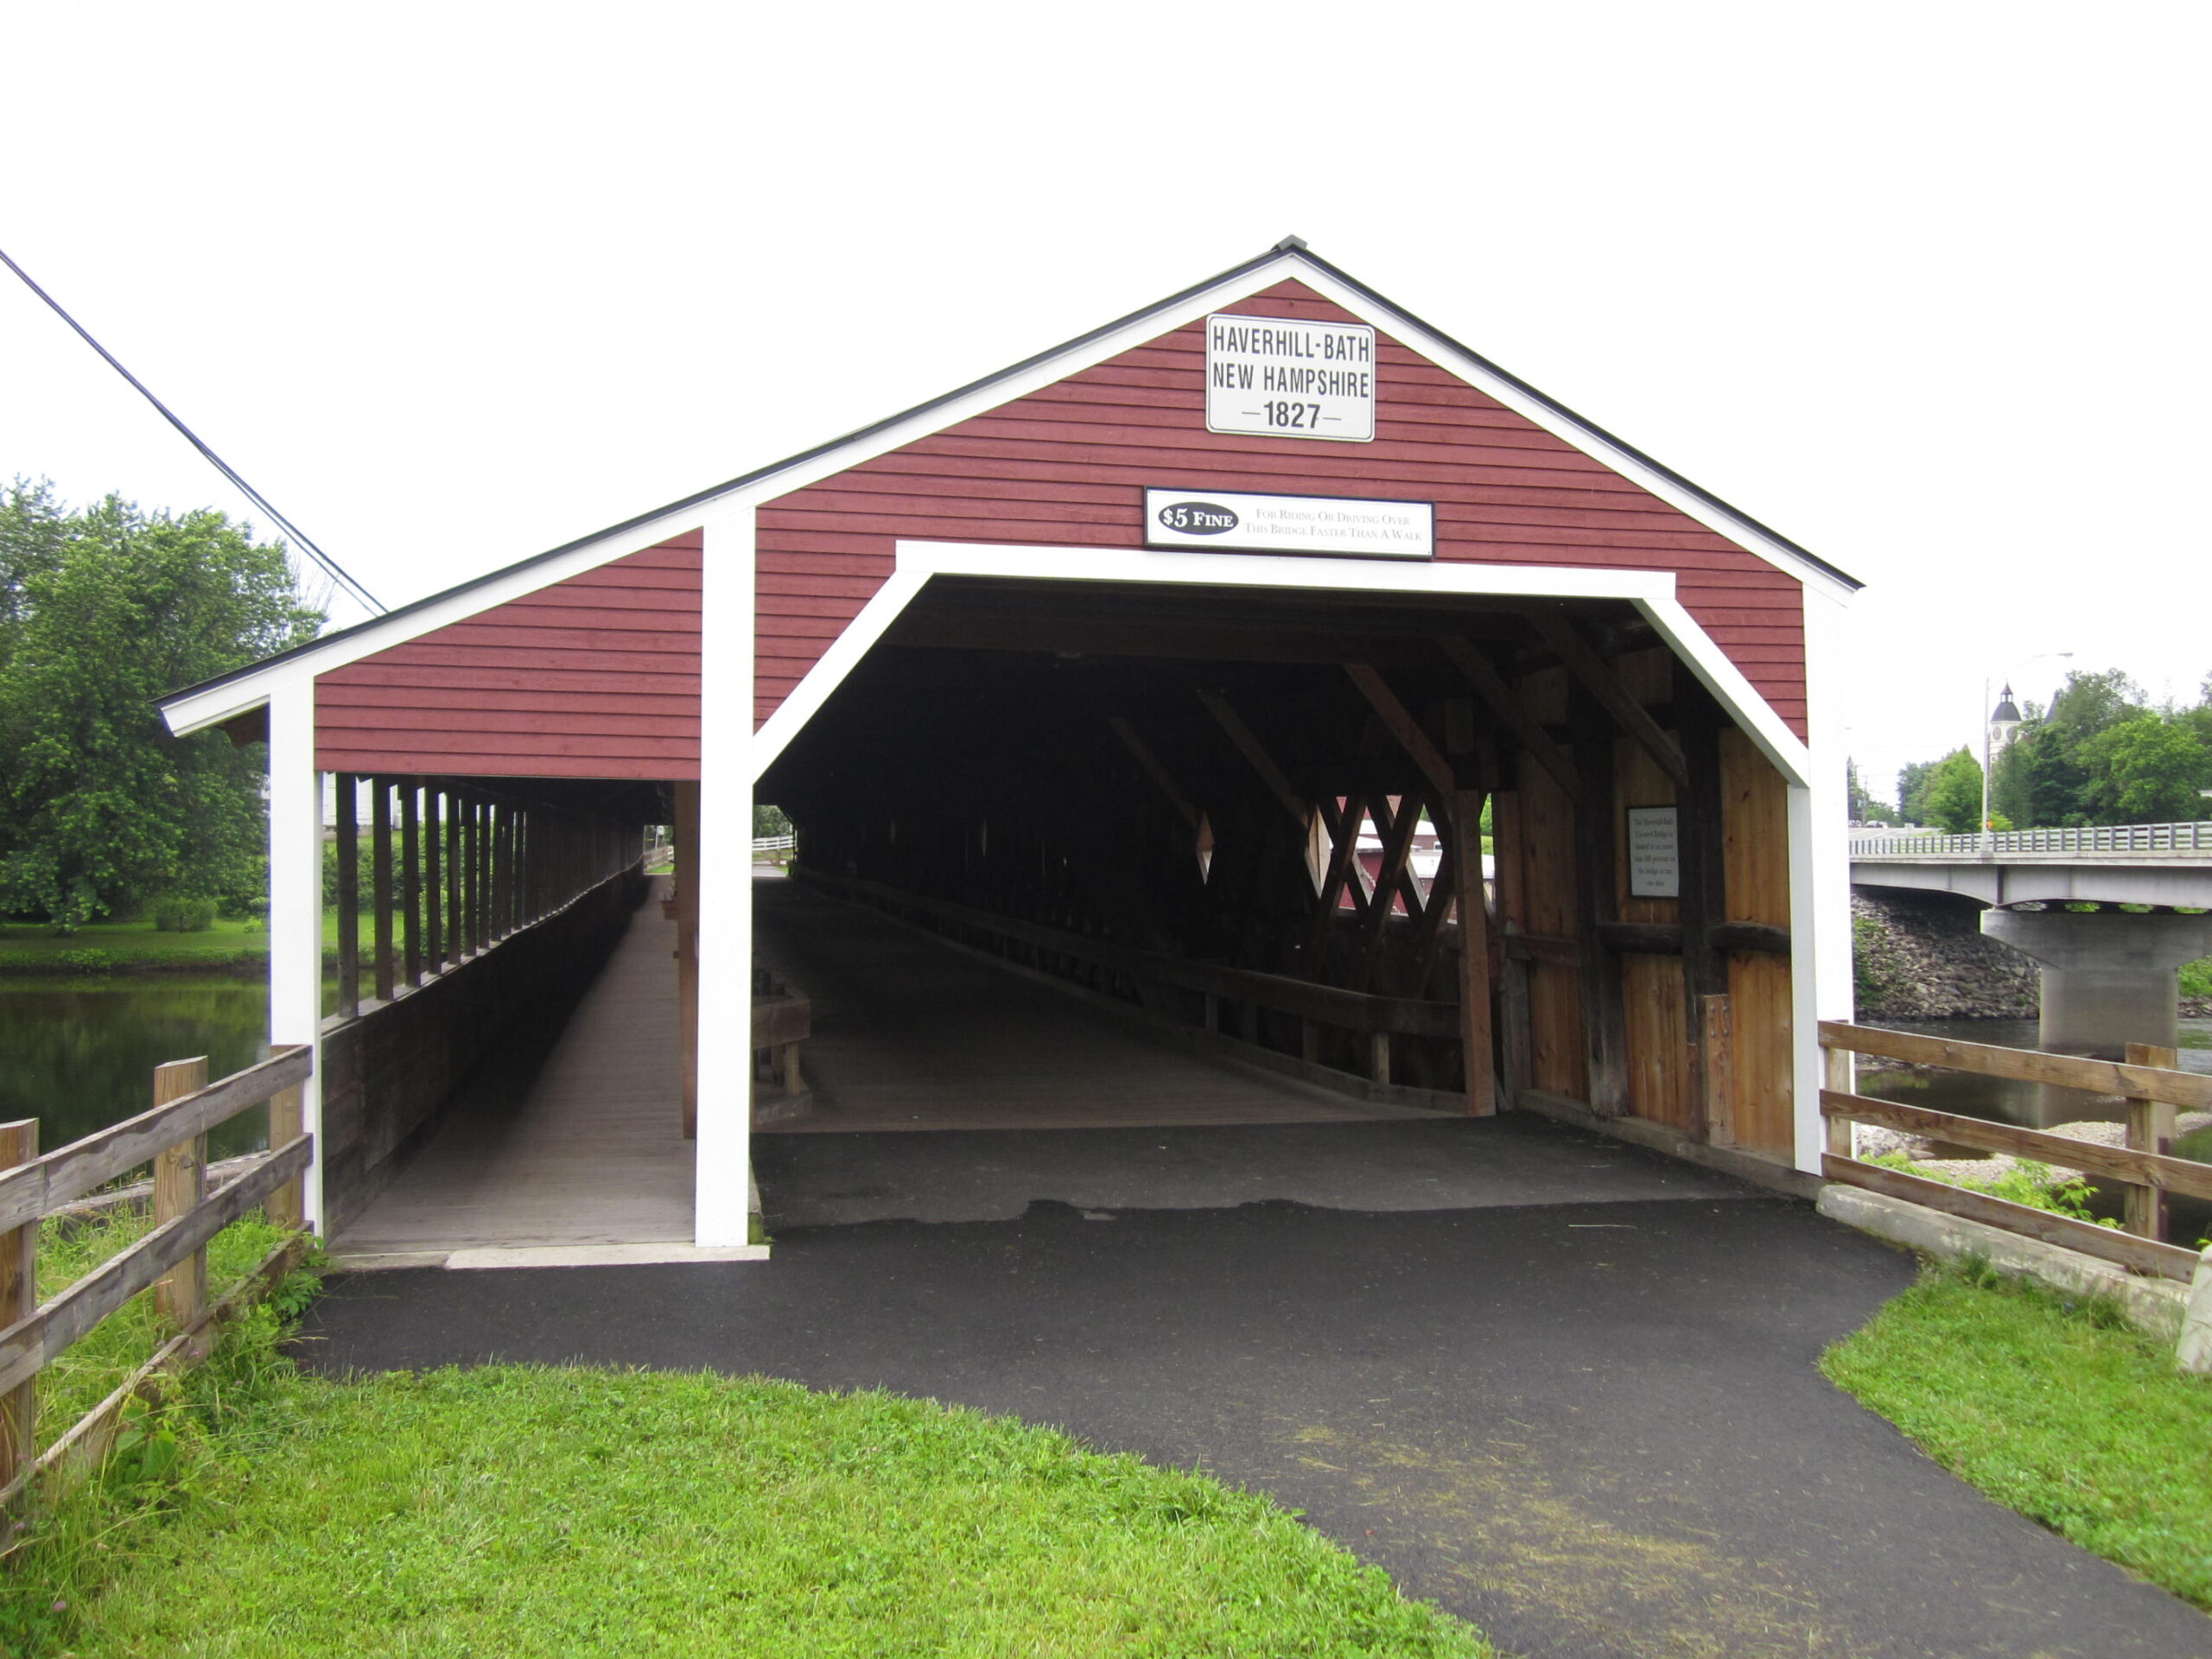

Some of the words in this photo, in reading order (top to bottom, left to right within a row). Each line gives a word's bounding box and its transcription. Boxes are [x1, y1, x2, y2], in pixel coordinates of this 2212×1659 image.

[1213, 325, 1370, 363] HAVERHILL-BATH
[1213, 361, 1254, 390] NEW
[1263, 365, 1370, 398] HAMPSHIRE
[1162, 507, 1188, 528] $5
[1255, 507, 1277, 519] FOR
[1279, 509, 1316, 522] RIDING
[1318, 511, 1334, 522] OR
[1337, 512, 1381, 524] DRIVING
[1382, 513, 1411, 526] OVER
[1243, 522, 1268, 534] THIS
[1270, 523, 1308, 537] BRIDGE
[1310, 524, 1347, 537] FASTER
[1348, 527, 1377, 539] THAN
[1381, 528, 1389, 539] A
[1391, 528, 1422, 541] WALK
